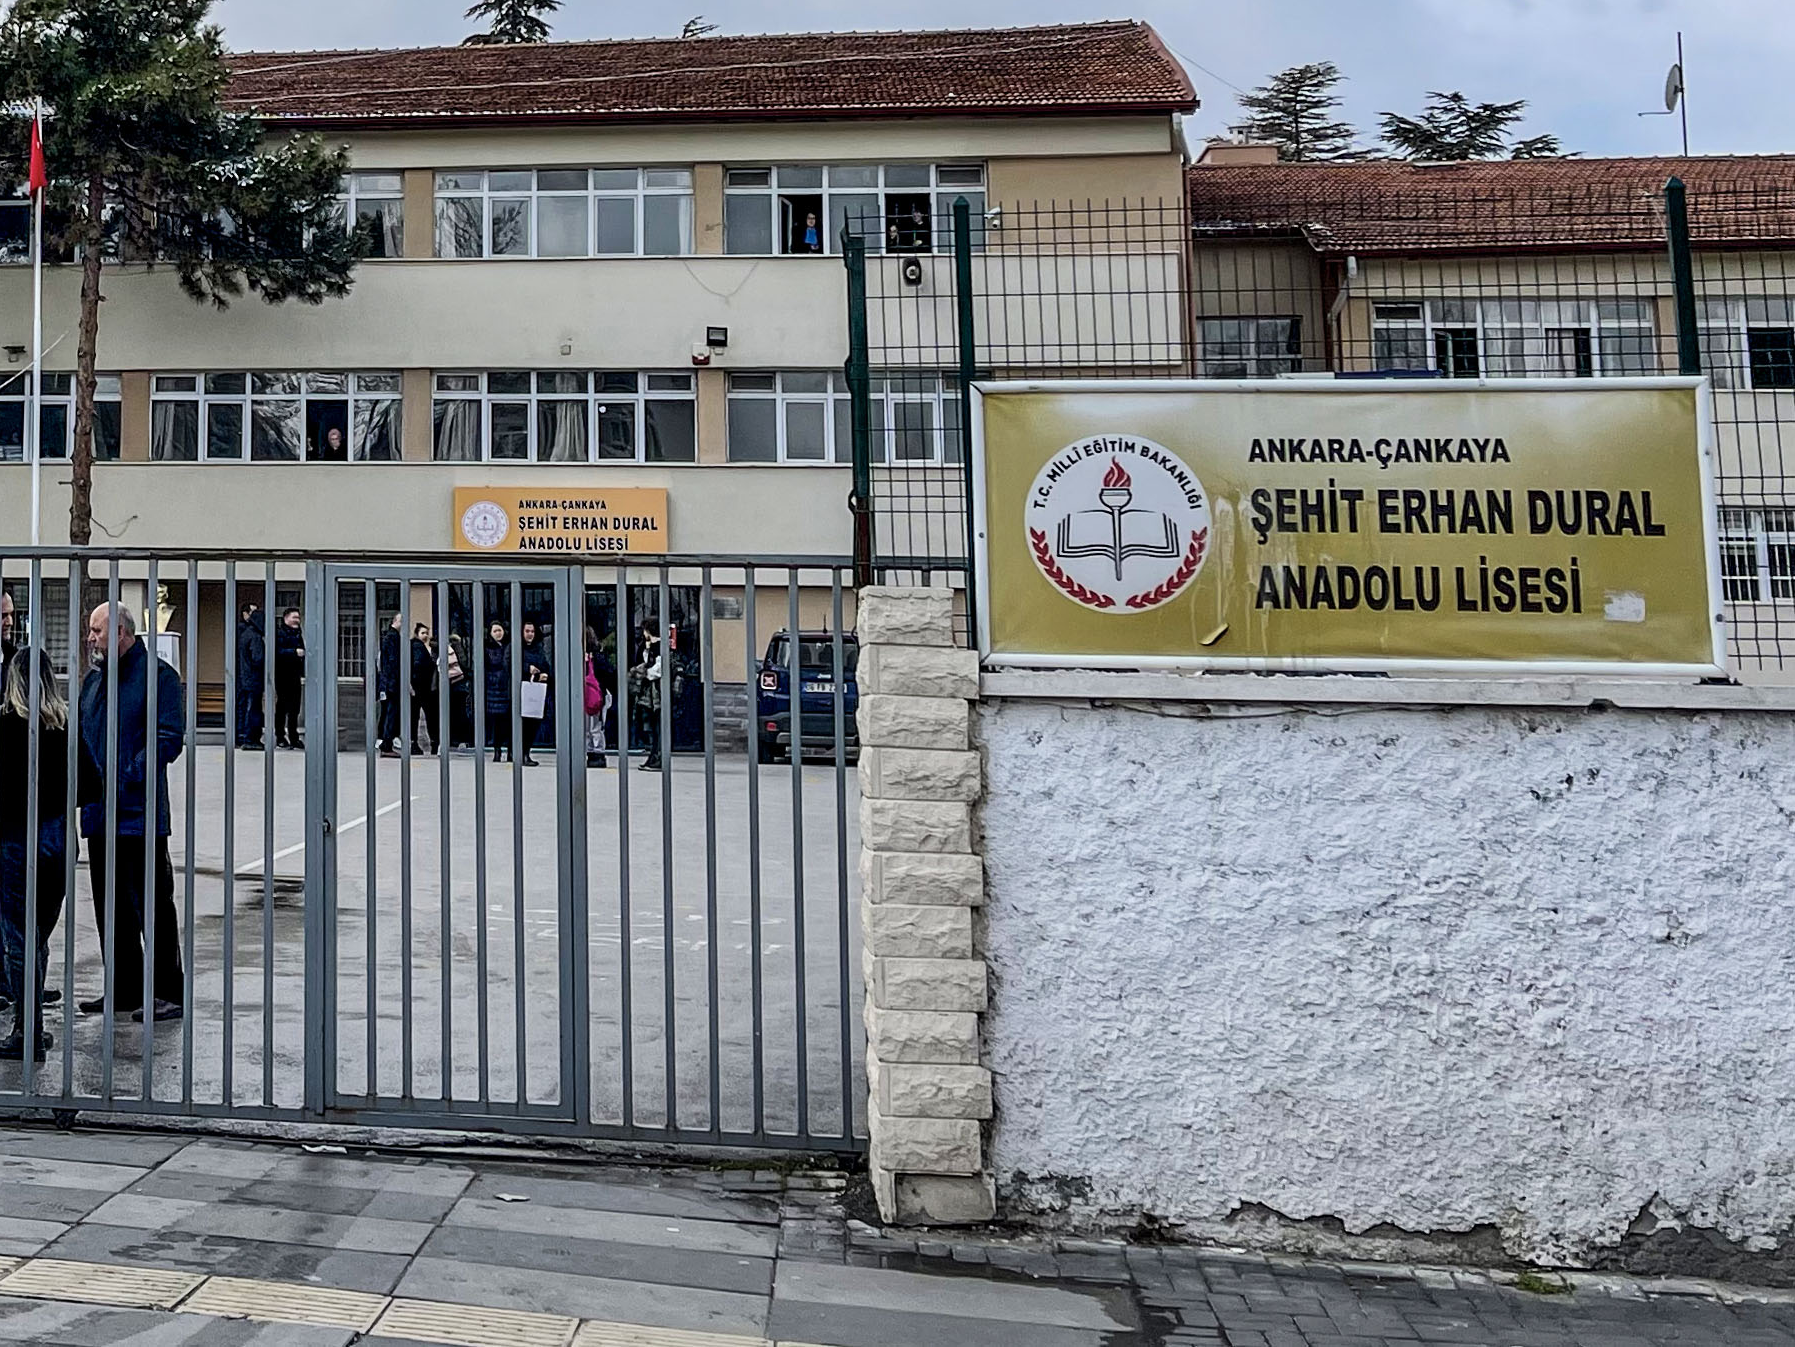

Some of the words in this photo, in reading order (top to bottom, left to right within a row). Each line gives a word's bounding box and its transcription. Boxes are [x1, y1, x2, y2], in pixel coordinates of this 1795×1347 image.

[1033, 485, 1053, 509] T.C.
[1084, 438, 1136, 457] EĞİTİM
[1139, 445, 1202, 510] BAKANLIĞI
[1248, 438, 1512, 469] ANKARA-ÇANKAYA
[518, 514, 558, 532] ŞEHİT
[563, 516, 608, 530] ERHAN
[613, 517, 658, 531] DURAL
[1251, 478, 1364, 545] ŞEHİT
[1378, 489, 1514, 534] ERHAN
[1527, 490, 1666, 537] DURAL
[519, 536, 582, 551] ANADOLU
[586, 534, 629, 551] LİSESİ
[1255, 565, 1441, 612] ANADOLU
[1455, 556, 1582, 614] LİSESİ
